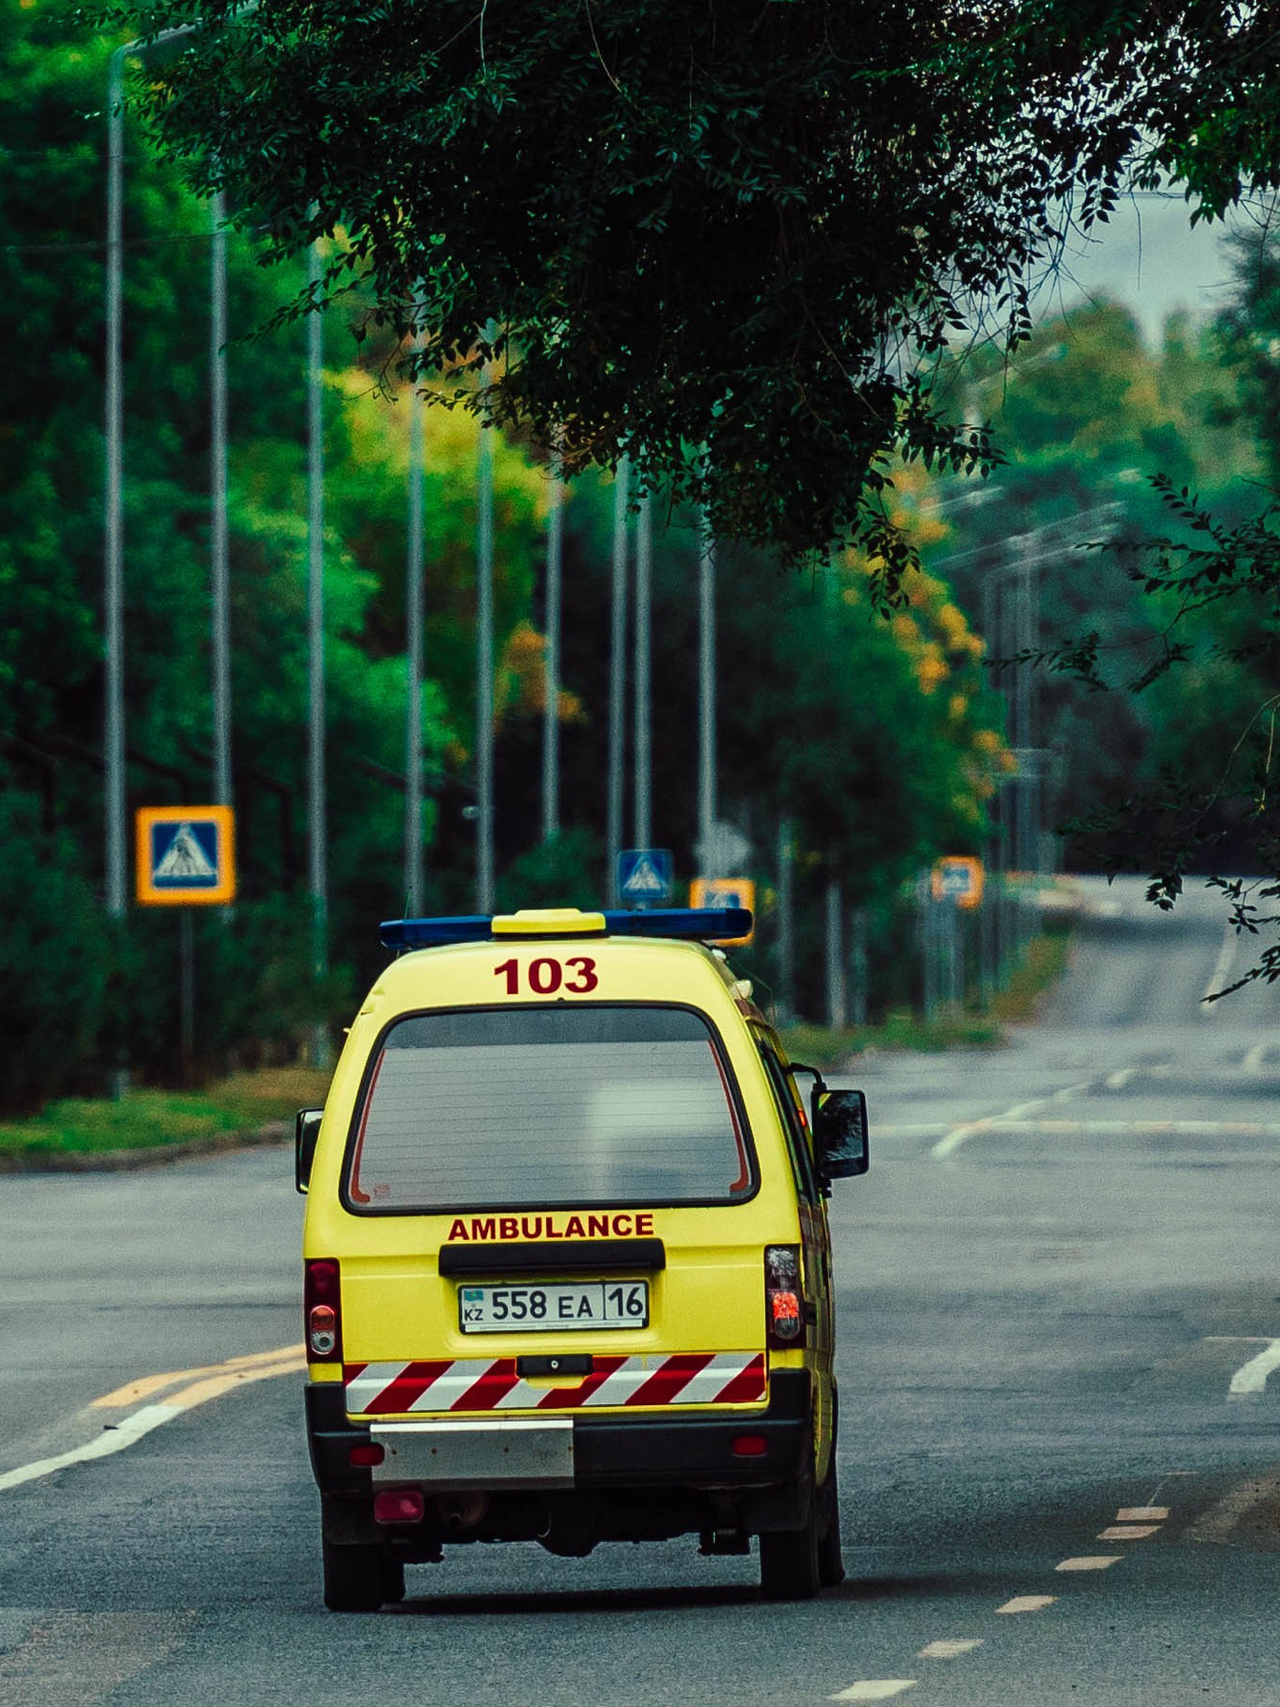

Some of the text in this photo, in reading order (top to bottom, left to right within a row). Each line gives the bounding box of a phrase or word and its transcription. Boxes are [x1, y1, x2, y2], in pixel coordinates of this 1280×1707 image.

[494, 957, 598, 995] 103
[447, 1214, 654, 1241] AMBULANCE
[464, 1287, 643, 1321] KZ 558 EA 16
